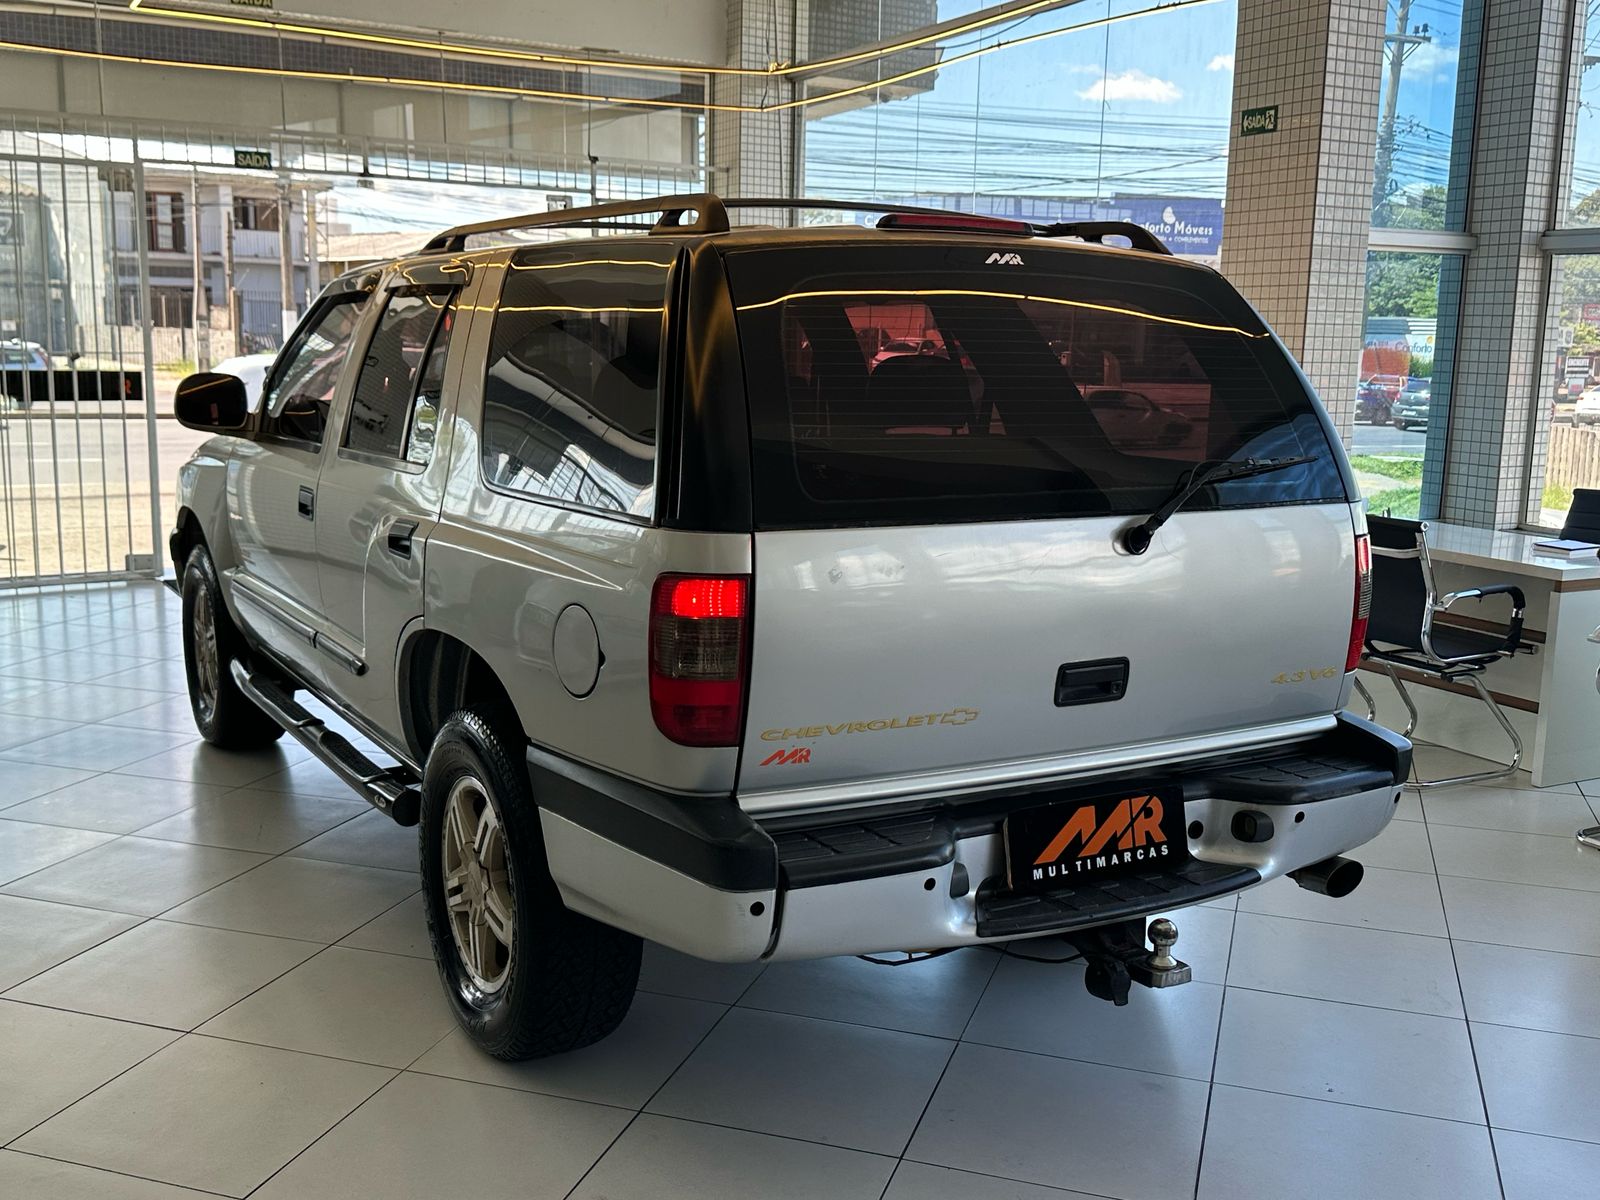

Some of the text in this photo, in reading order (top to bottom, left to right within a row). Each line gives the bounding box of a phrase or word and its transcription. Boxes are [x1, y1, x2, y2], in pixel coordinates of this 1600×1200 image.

[237, 152, 270, 168] SAÍDA
[1174, 221, 1213, 235] Móveis
[1395, 341, 1433, 353] Conforto
[760, 713, 941, 742] CHEVROLET
[1032, 844, 1169, 881] MULTIMARCAS
